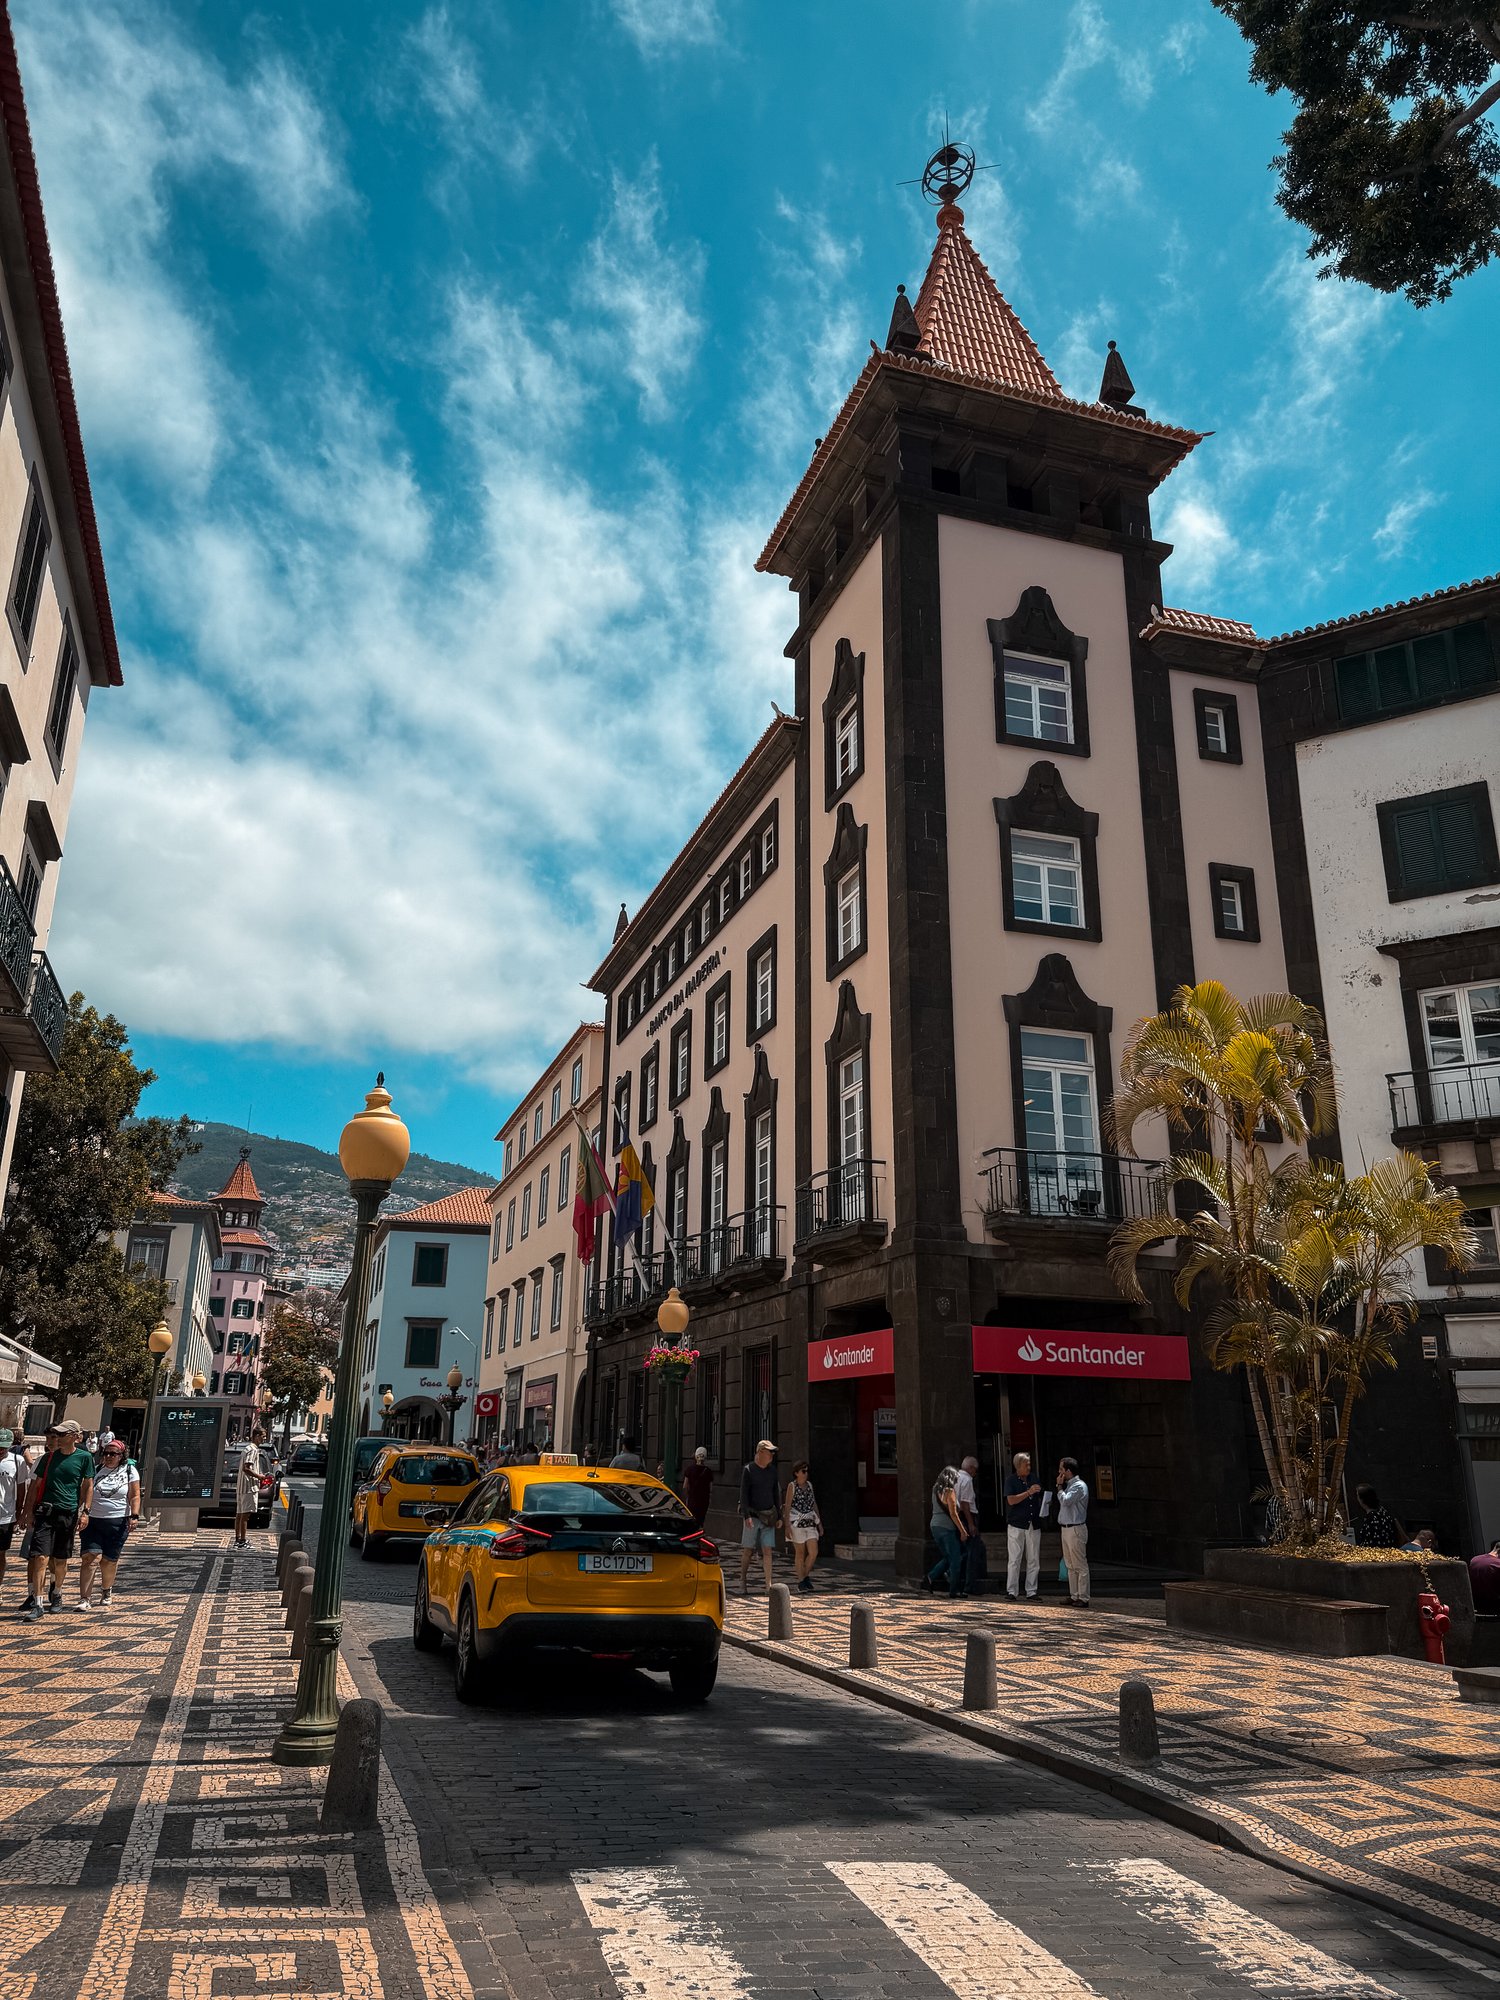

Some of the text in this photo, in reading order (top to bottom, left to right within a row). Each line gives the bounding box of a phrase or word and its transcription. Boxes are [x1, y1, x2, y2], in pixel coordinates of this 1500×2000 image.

[650, 951, 720, 1035] BANCO DA MADEIRA
[833, 1345, 875, 1367] Santander
[1045, 1342, 1145, 1366] Santander
[554, 1456, 570, 1464] TAXI
